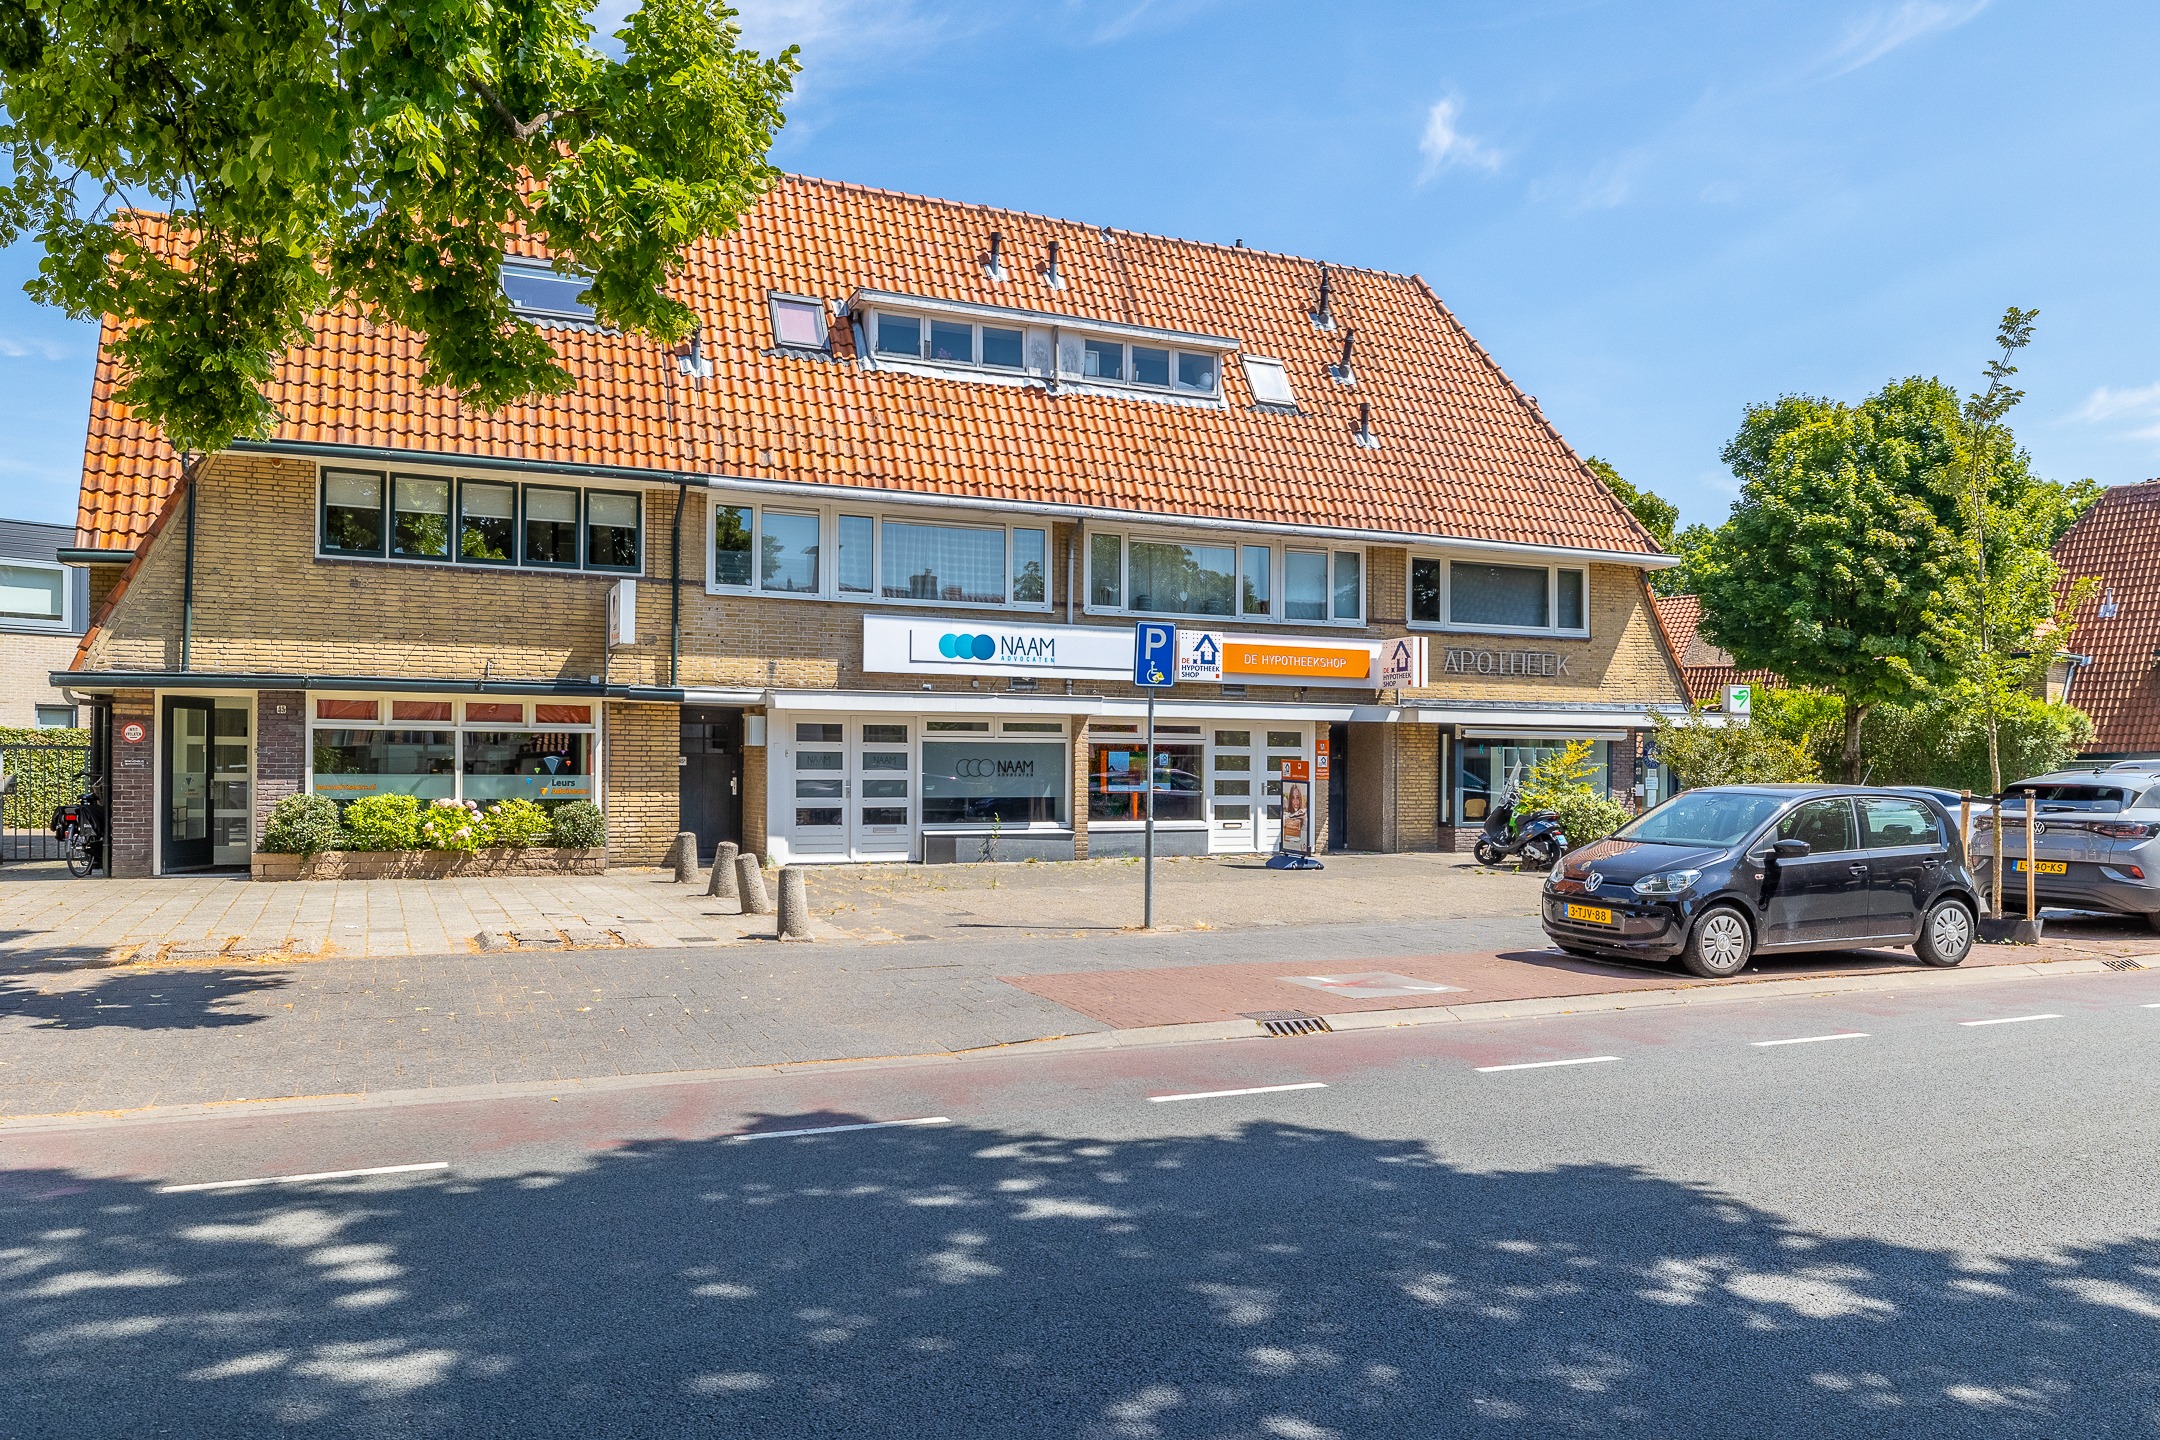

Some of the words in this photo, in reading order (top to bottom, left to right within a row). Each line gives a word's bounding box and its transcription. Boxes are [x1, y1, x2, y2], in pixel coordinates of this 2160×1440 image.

[1001, 635, 1055, 657] NAAM
[1145, 628, 1166, 659] P
[1001, 655, 1055, 663] ADVOCATEN
[1244, 653, 1258, 665] DE
[1261, 655, 1347, 669] HYPOTHEEKSHOP
[1444, 650, 1570, 676] APOTHEEK
[1383, 672, 1411, 680] HYPOTHEEK
[807, 755, 831, 763] NAAM
[873, 755, 897, 763] NAAM
[997, 760, 1034, 773] NAAM
[551, 778, 576, 787] Leurs
[2019, 861, 2064, 873] L-40-KS
[1570, 906, 1606, 921] 3-TJV-88
